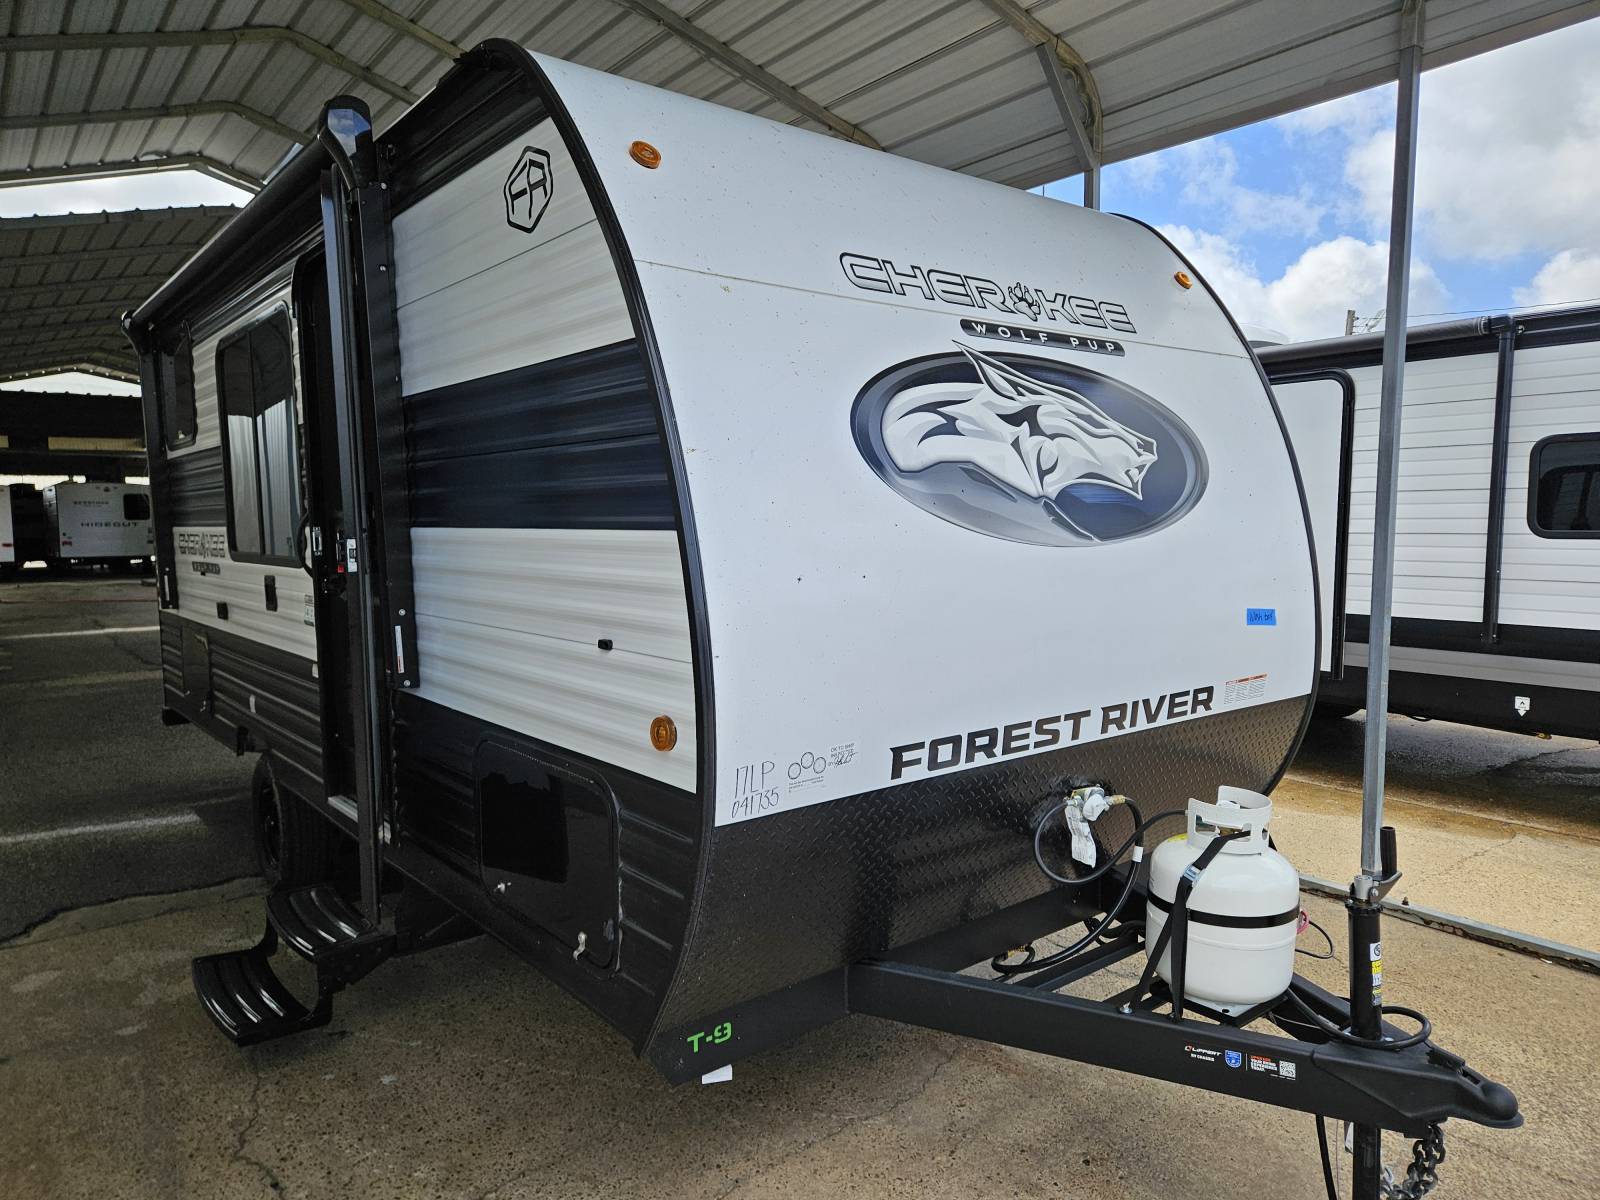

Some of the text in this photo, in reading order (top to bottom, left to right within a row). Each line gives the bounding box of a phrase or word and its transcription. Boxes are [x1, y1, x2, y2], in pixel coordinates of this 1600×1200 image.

[839, 252, 1137, 333] CHEROKEE
[971, 322, 1116, 353] WOLF PUP
[889, 685, 1215, 780] FOREST RIVER
[687, 1022, 732, 1053] T-9
